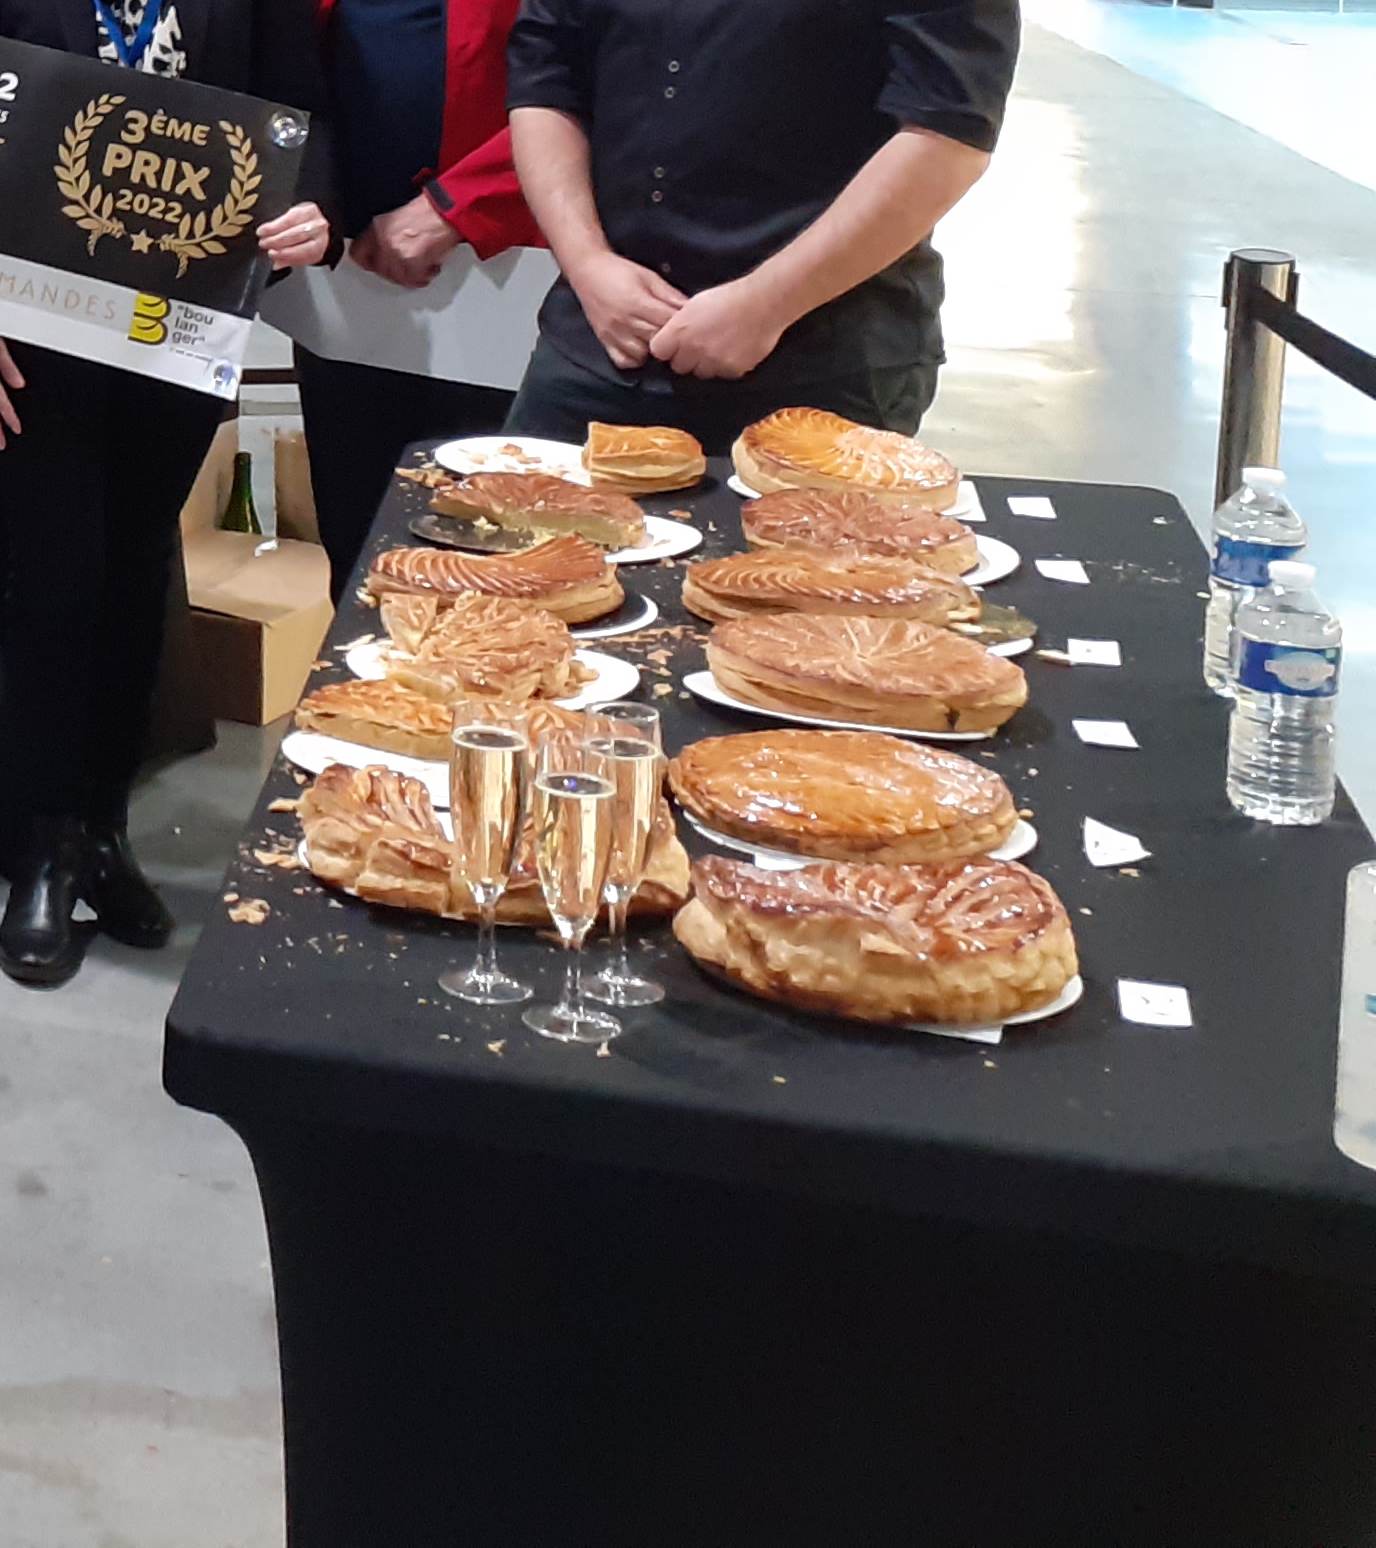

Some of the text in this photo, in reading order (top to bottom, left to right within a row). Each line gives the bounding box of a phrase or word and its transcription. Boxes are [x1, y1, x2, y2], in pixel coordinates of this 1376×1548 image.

[120, 108, 211, 146] 3ÈME
[102, 142, 210, 201] PRIX
[115, 189, 183, 224] 2022
[174, 316, 199, 334] lan
